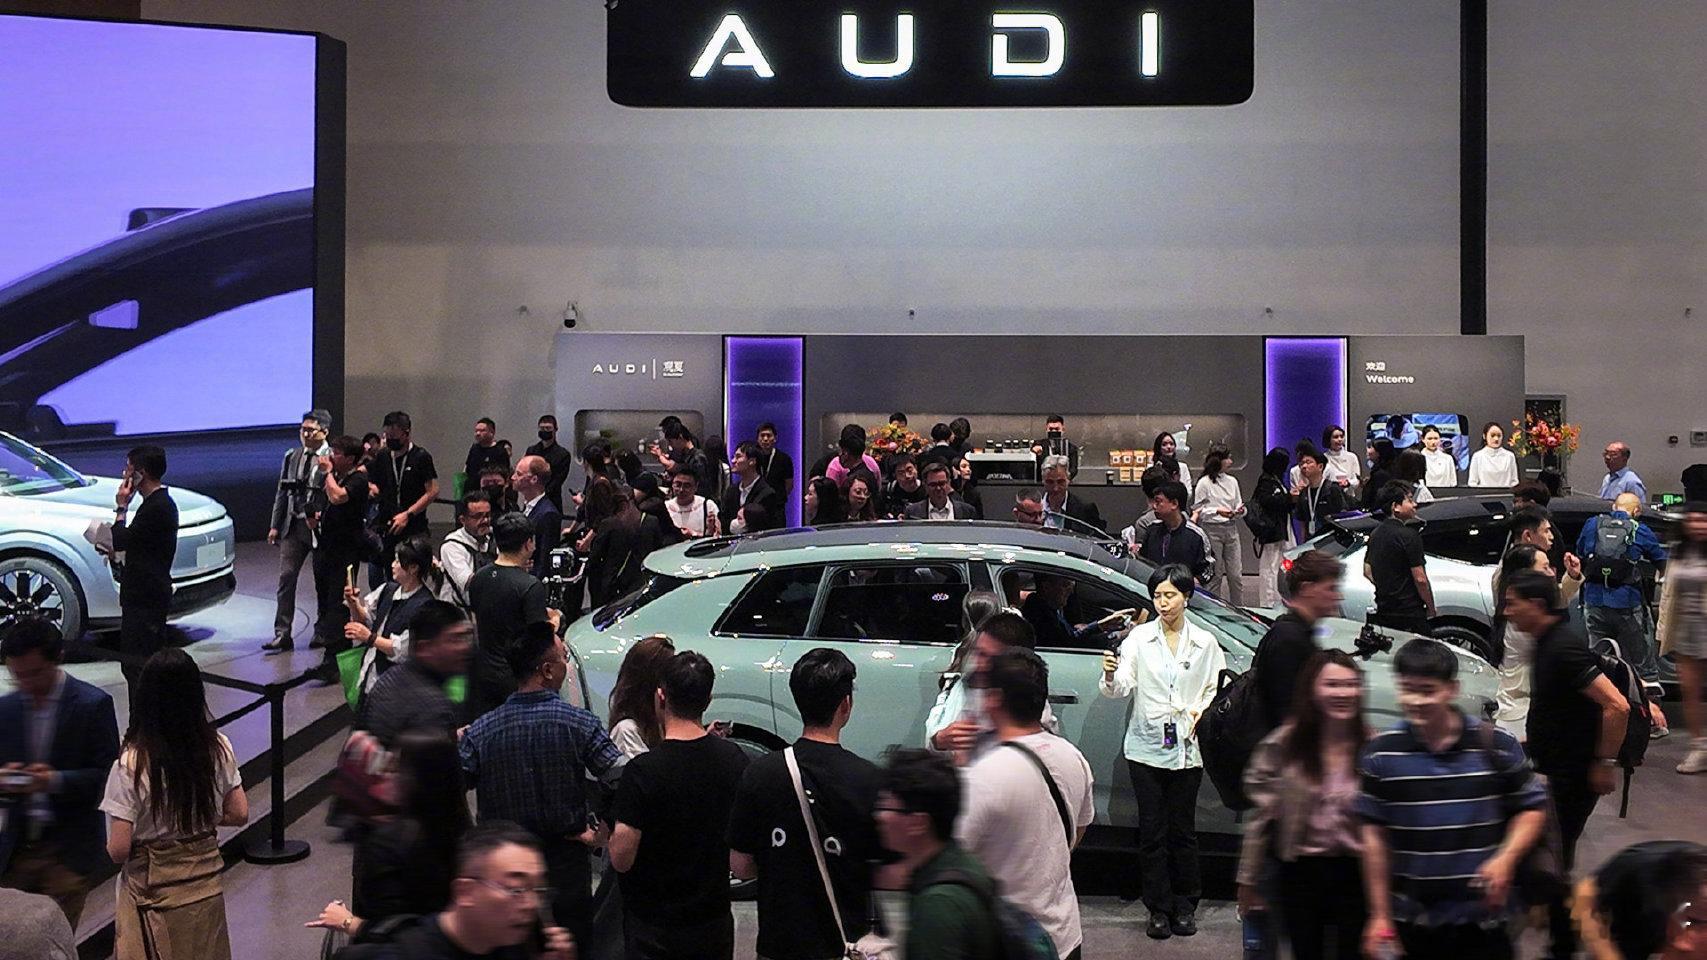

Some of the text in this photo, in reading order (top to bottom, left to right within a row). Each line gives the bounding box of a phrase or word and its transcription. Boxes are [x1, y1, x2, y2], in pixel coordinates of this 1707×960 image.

[690, 12, 1159, 78] AUDI
[592, 364, 646, 373] AUDI
[1365, 361, 1386, 371] 欢迎
[1365, 375, 1415, 383] Welcome
